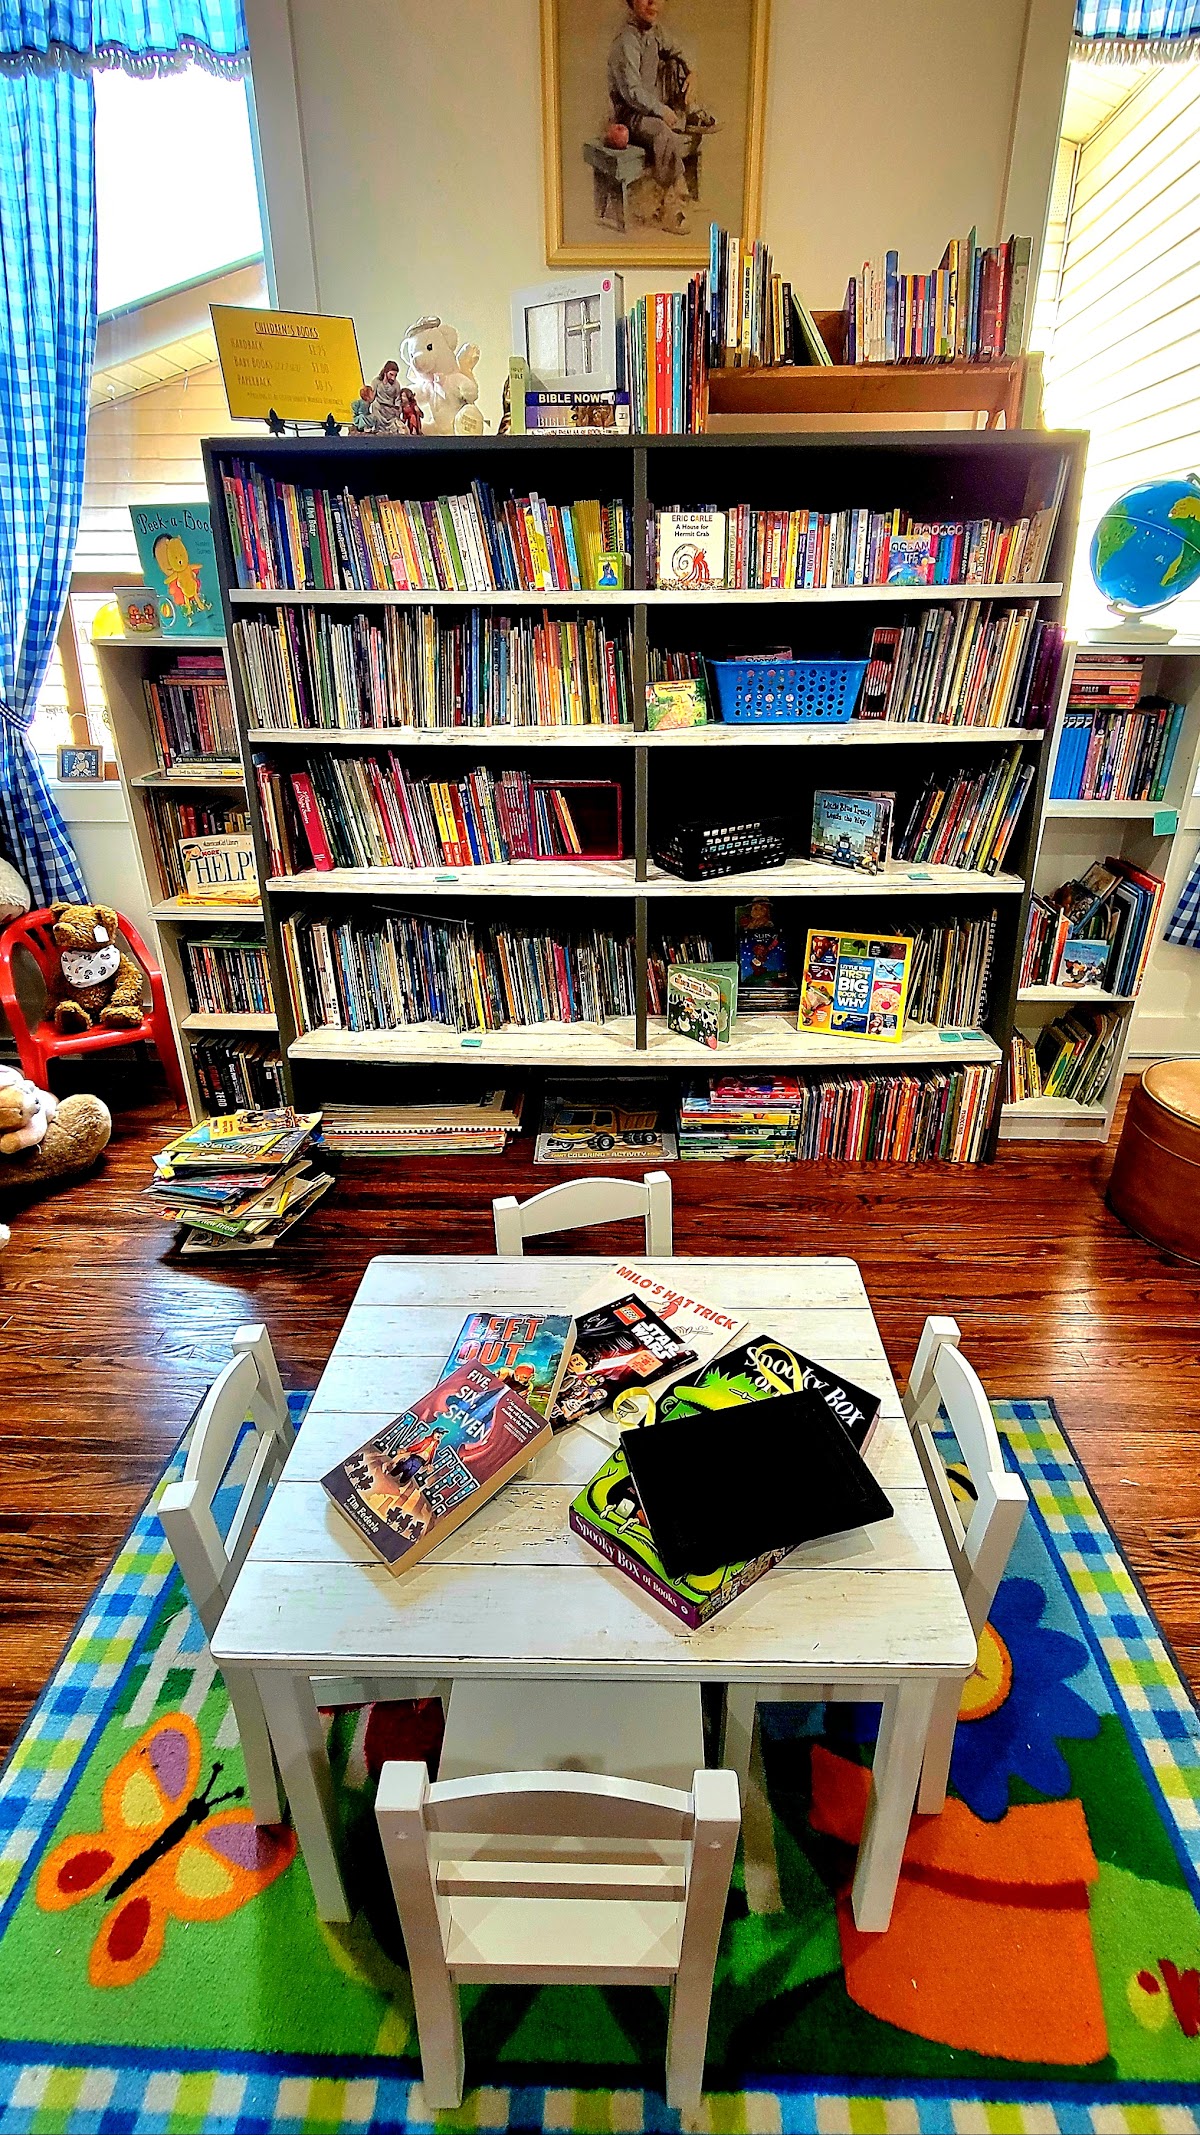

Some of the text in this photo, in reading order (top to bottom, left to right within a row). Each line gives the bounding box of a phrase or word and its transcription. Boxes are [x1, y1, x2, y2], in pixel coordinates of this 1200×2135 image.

[254, 321, 319, 338] CHILDREN'S BOOKS
[234, 356, 249, 368] BABY
[251, 357, 273, 369] BOOKS
[237, 374, 272, 387] PAPERBACK
[538, 393, 571, 403] BIBLE
[671, 514, 713, 522] ERIC CARLE
[891, 540, 929, 552] OCEAN
[853, 804, 872, 818] Truck
[195, 850, 257, 885] HELP!
[840, 970, 872, 979] FIRST
[838, 977, 869, 993] BIG
[837, 997, 867, 1008] WHY
[215, 1091, 227, 1107] ZERO
[217, 1221, 239, 1233] Friend
[616, 1266, 739, 1331] MILO'S HAT TRICK
[621, 1307, 639, 1321] LEGO
[465, 1316, 545, 1342] LEFT
[631, 1323, 673, 1360] WARS
[639, 1320, 681, 1358] STAR
[454, 1340, 526, 1367] OUT
[466, 1369, 492, 1391] FIVE,
[456, 1385, 481, 1410] SIX,
[346, 1493, 379, 1533] Tim Federle
[575, 1515, 616, 1559] Spooky
